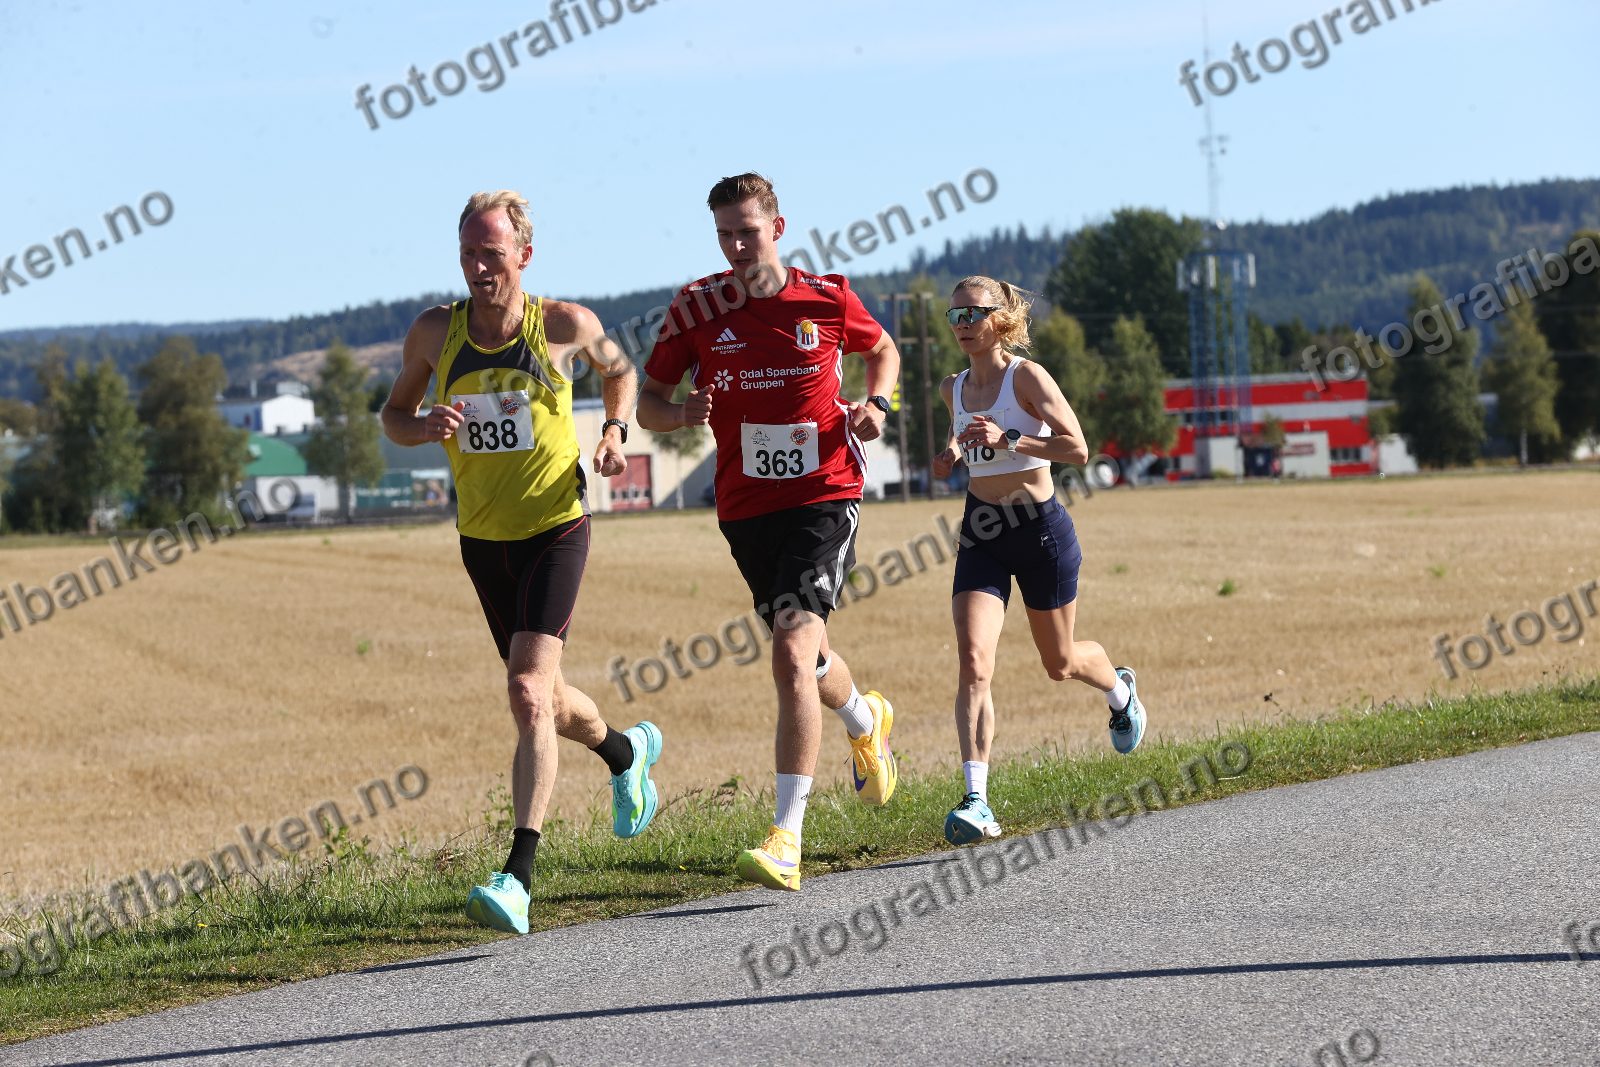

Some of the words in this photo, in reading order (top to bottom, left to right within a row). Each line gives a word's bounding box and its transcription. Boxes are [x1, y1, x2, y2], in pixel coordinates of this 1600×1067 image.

[739, 369, 764, 380] Odal
[765, 364, 821, 379] Sparebank
[740, 379, 785, 391] Gruppen
[467, 418, 519, 451] 838
[755, 448, 805, 477] 363
